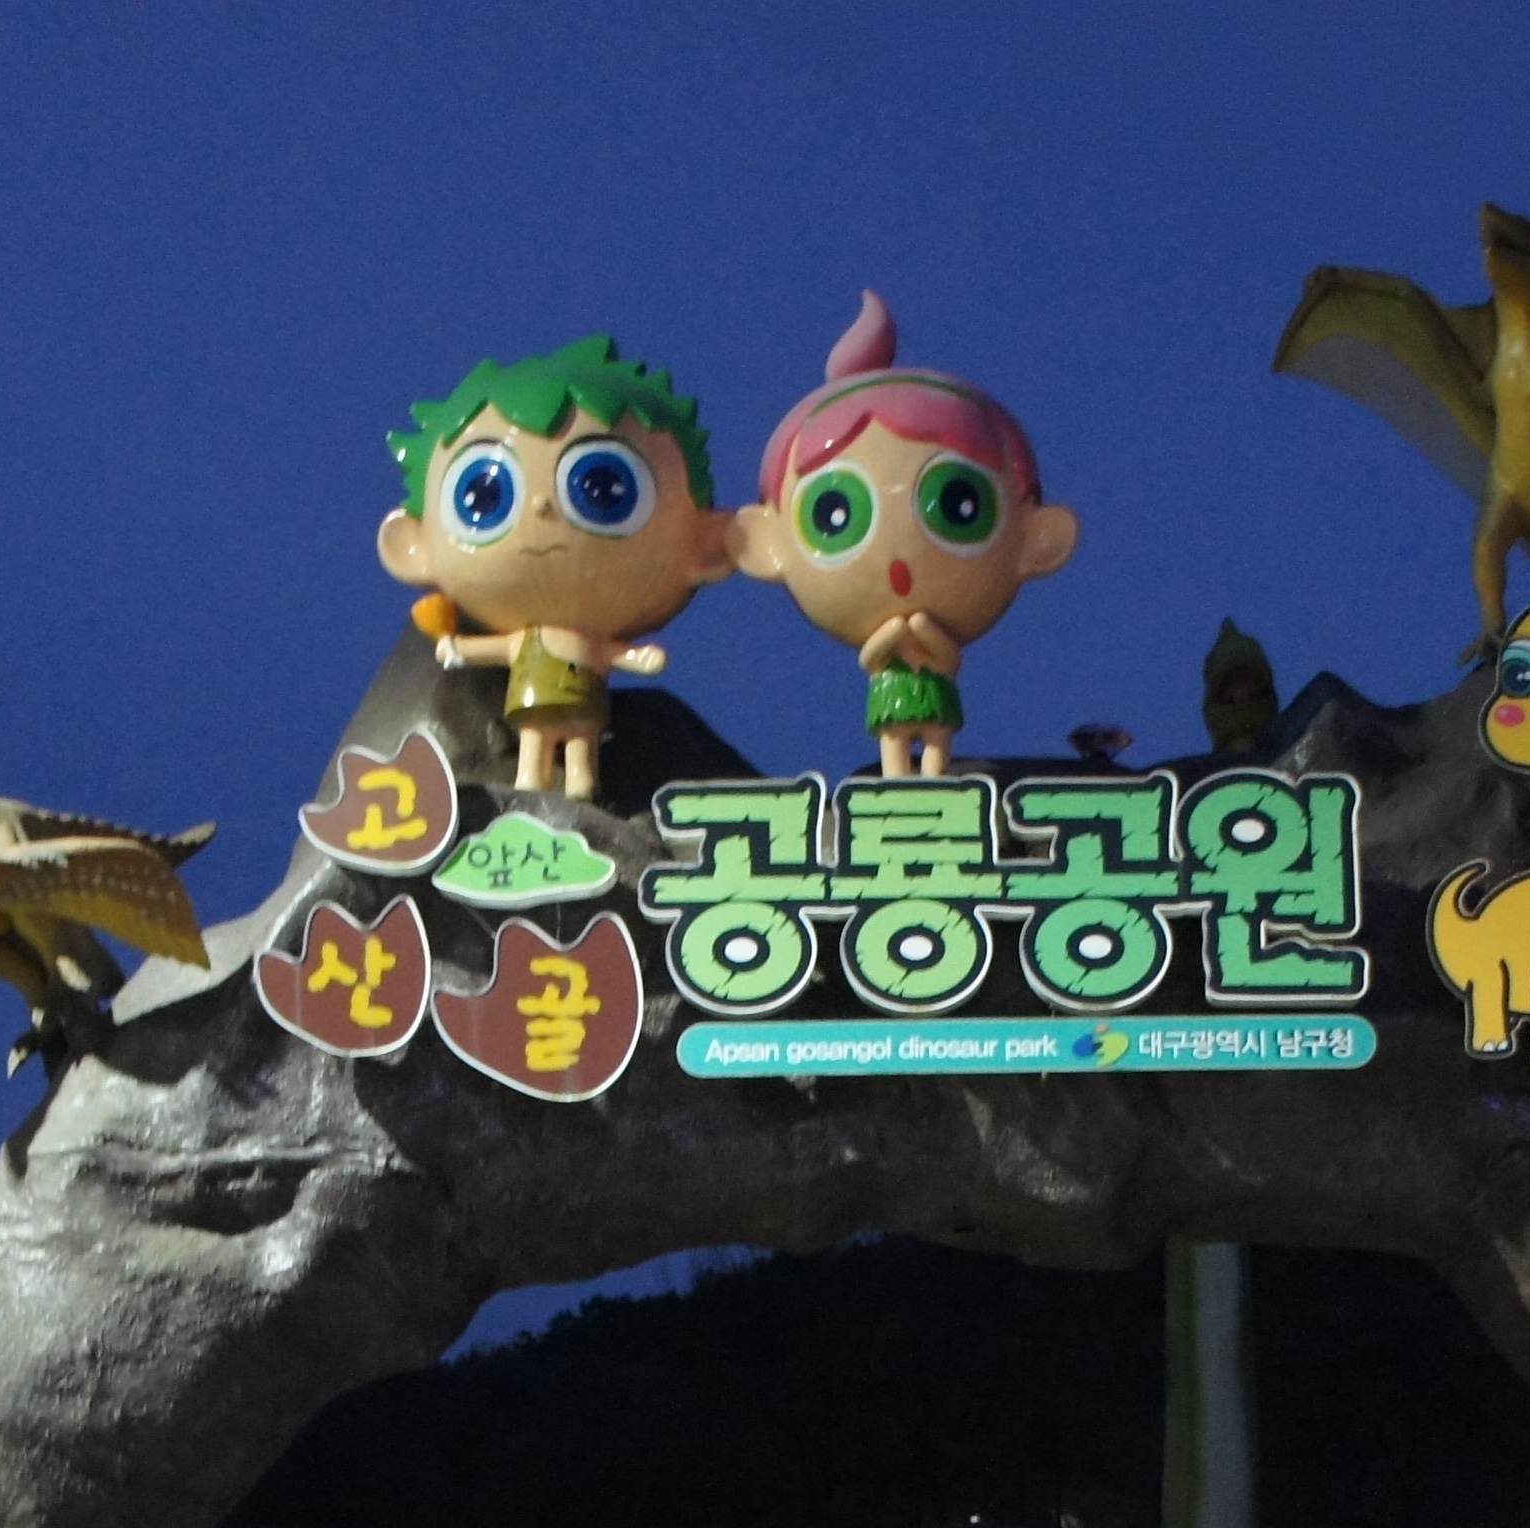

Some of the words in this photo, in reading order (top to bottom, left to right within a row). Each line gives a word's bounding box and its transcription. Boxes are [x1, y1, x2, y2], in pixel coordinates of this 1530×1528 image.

[348, 768, 427, 849] 고
[469, 839, 566, 887] 앞산
[654, 782, 1353, 1002] 공룡공원
[307, 936, 396, 1028] 산
[517, 955, 601, 1072] 골
[704, 1038, 779, 1065] Apsan
[786, 1037, 891, 1066] gosangol
[898, 1036, 997, 1060] dinosaur
[1005, 1036, 1058, 1062] park
[1138, 1030, 1266, 1058] 대구광역시
[1277, 1028, 1354, 1056] 남구청
